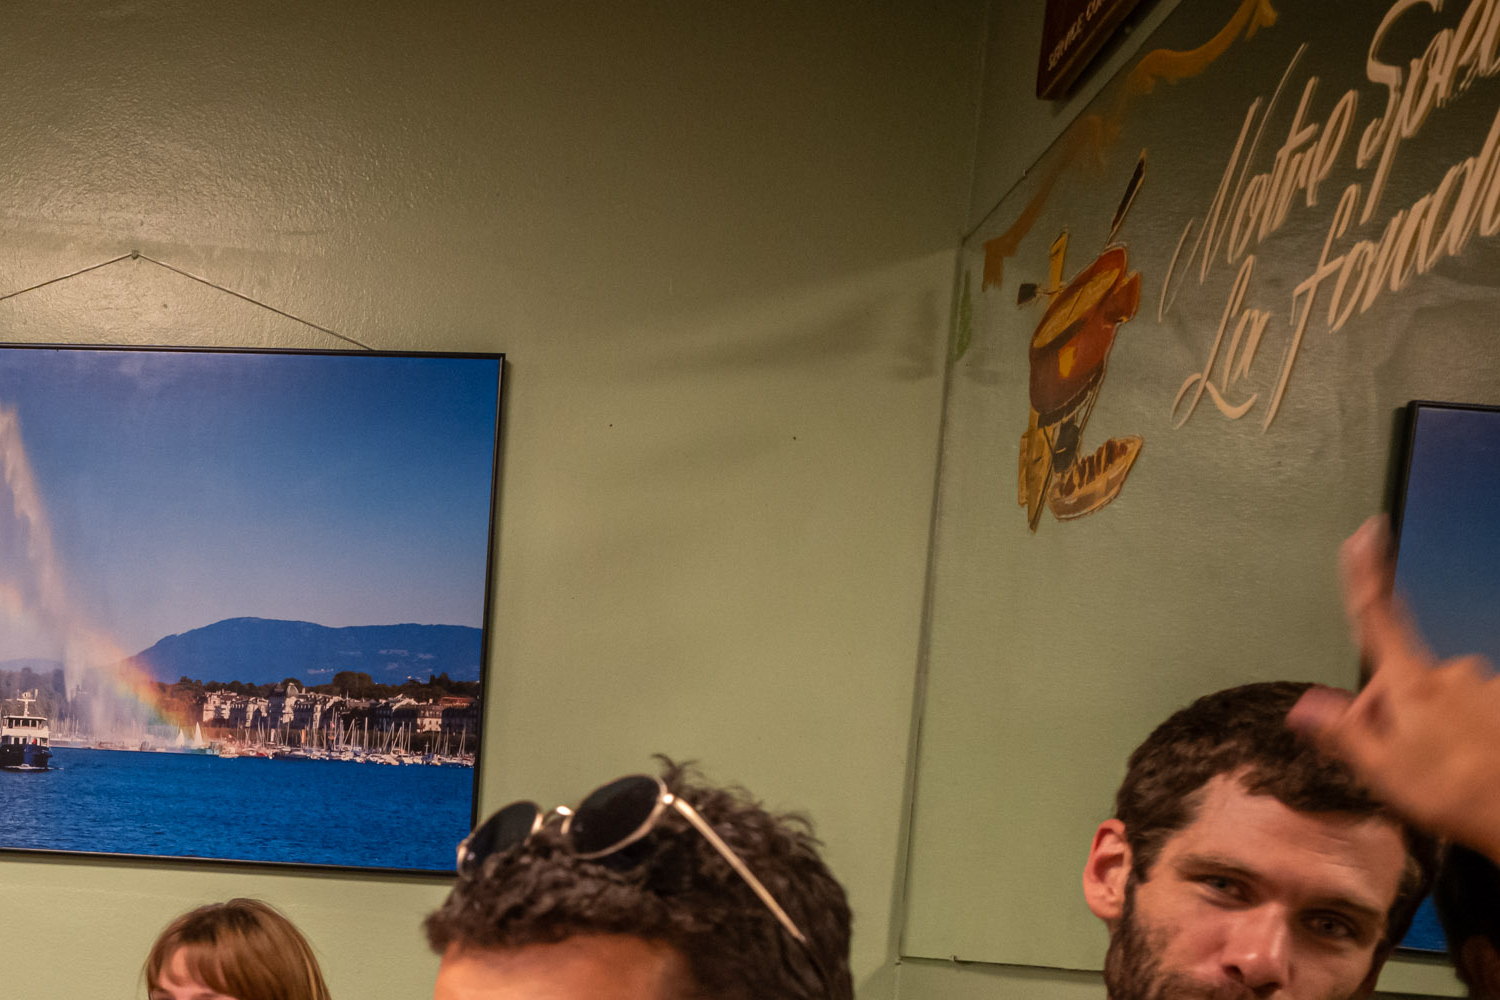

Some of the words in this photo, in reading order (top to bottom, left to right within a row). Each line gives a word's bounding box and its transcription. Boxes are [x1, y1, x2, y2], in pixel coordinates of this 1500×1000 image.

[1047, 12, 1085, 72] SERVICE
[1158, 42, 1359, 324] Notre
[1171, 254, 1271, 430] La
